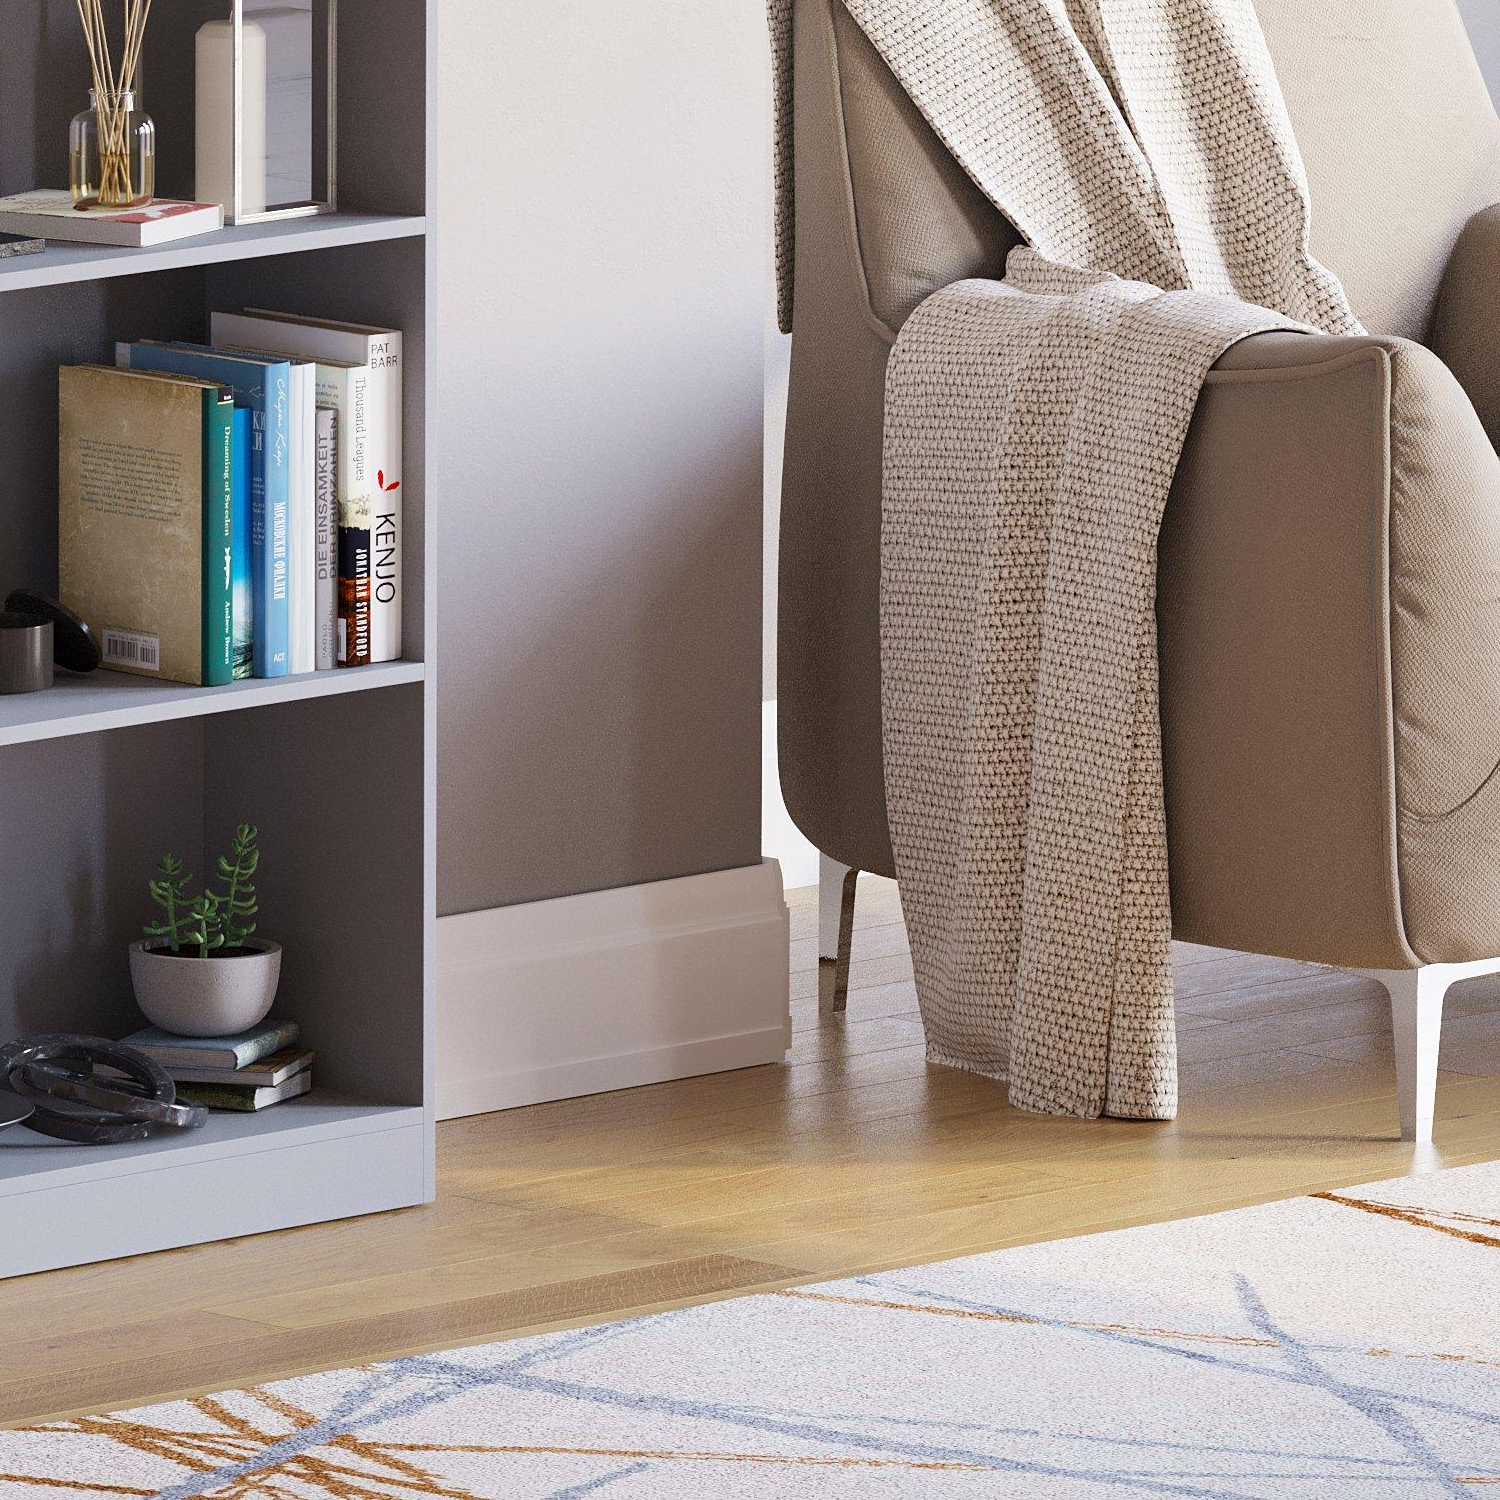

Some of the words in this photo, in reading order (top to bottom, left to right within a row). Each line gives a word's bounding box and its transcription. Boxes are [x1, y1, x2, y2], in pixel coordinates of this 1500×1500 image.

[371, 342, 390, 354] PAT
[371, 355, 398, 369] BARR
[355, 377, 366, 434] Thousand
[223, 426, 231, 479] Dreaming
[352, 436, 366, 481] Leagues
[223, 481, 231, 492] of
[318, 433, 328, 545] EINSAMKEIT
[329, 417, 337, 535] PRIMZAHLEN
[223, 494, 231, 536] Sweden
[318, 551, 328, 580] DIE
[329, 541, 337, 579] DER
[355, 548, 368, 598] JONATHAN
[375, 513, 396, 603] KENJO
[223, 600, 231, 634] Andrew
[355, 601, 368, 657] STANDFORD
[223, 636, 231, 665] Brown
